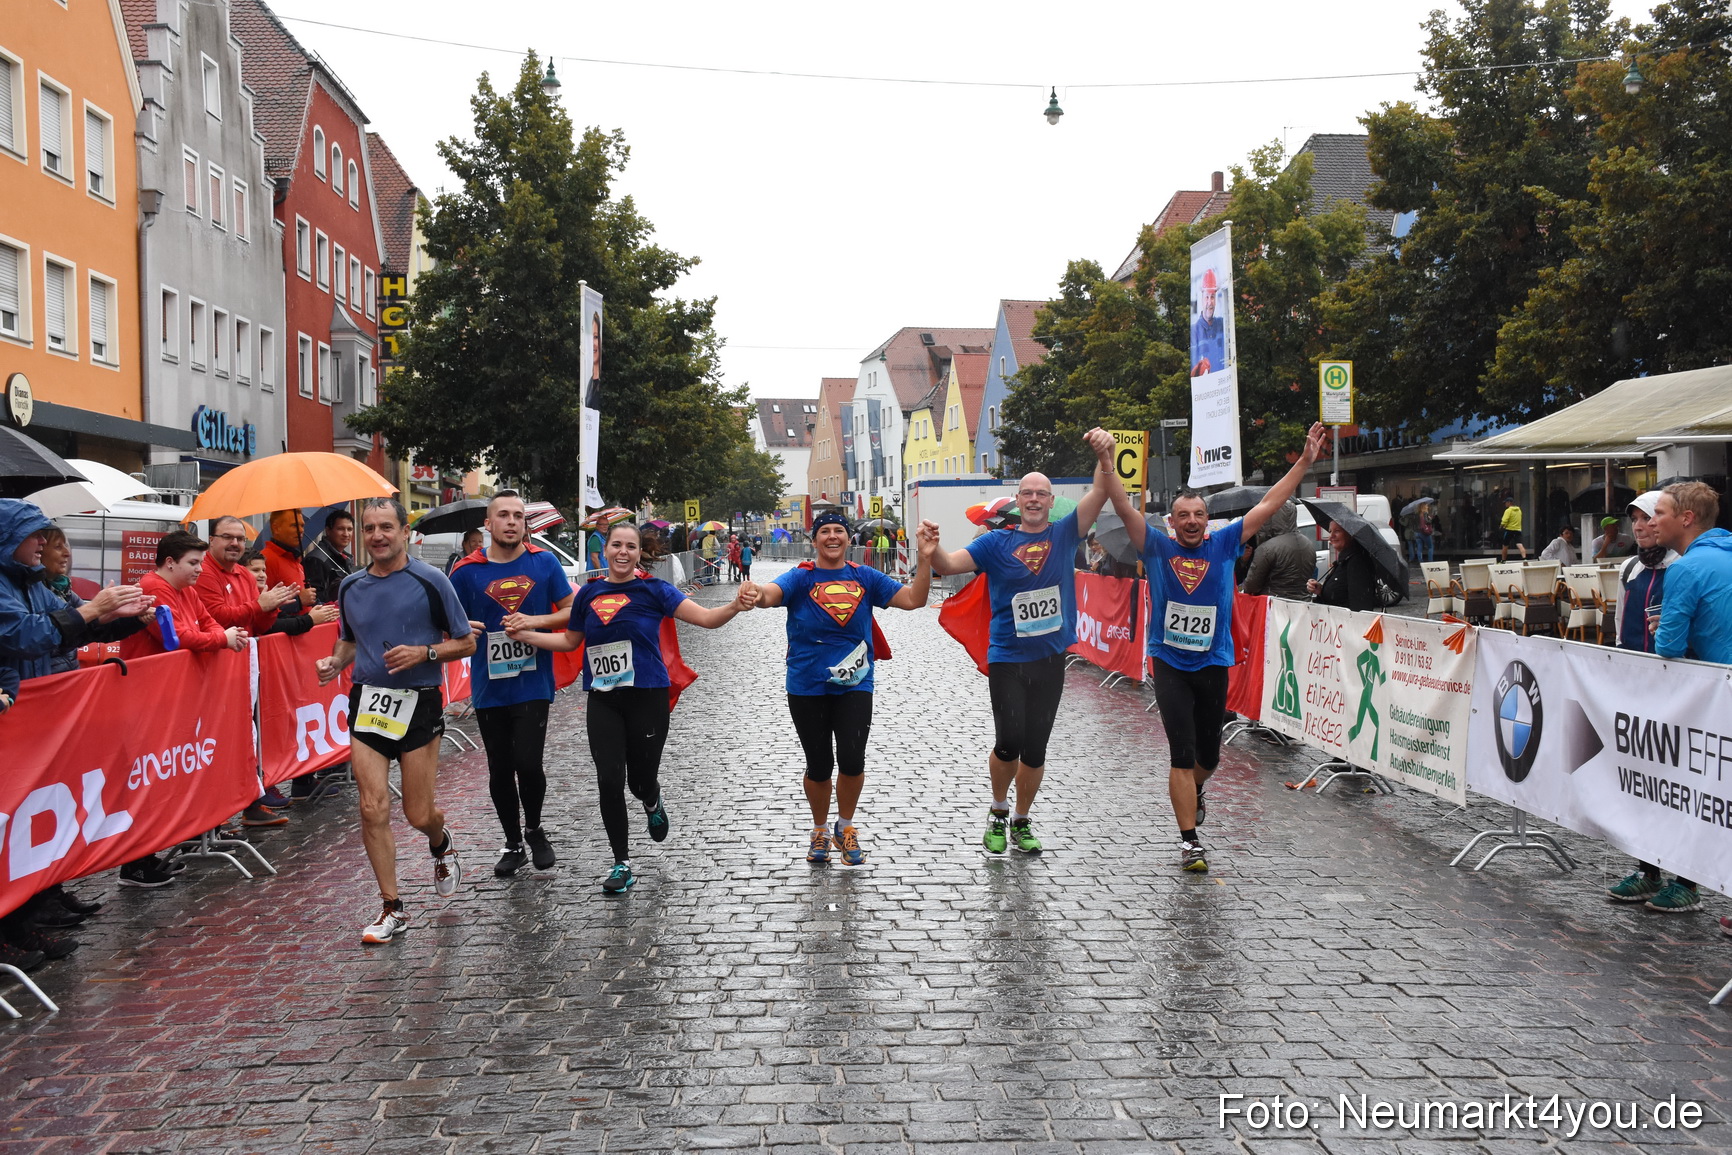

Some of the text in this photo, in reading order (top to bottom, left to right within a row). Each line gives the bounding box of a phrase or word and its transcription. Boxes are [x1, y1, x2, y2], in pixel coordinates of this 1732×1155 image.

[14, 386, 29, 399] Dianas
[195, 405, 245, 453] Eilles
[1113, 433, 1143, 444] Block
[1117, 449, 1137, 479] C
[689, 506, 696, 516] D
[873, 502, 880, 513] D
[129, 536, 161, 544] HEIZU
[128, 550, 157, 560] BÄDE
[1018, 598, 1058, 620] 3023
[1169, 613, 1210, 634] 2128
[490, 640, 534, 661] 2088
[1172, 634, 1204, 646] Wolfgang
[1394, 634, 1428, 652] Service-Line:
[507, 663, 522, 671] Max
[594, 652, 628, 676] 2061
[1391, 670, 1472, 694] www.jura-gebaeudeservice.de
[1497, 663, 1540, 706] BMW
[368, 692, 403, 718] 291
[370, 716, 389, 729] Klaus
[1304, 711, 1343, 748] BESSER
[1390, 704, 1450, 740] Gebäudereinigung
[1390, 728, 1450, 761] Hausmeisterdienst
[1614, 711, 1680, 768] BMW
[128, 717, 217, 790] energie
[1618, 766, 1690, 814] WENIGER
